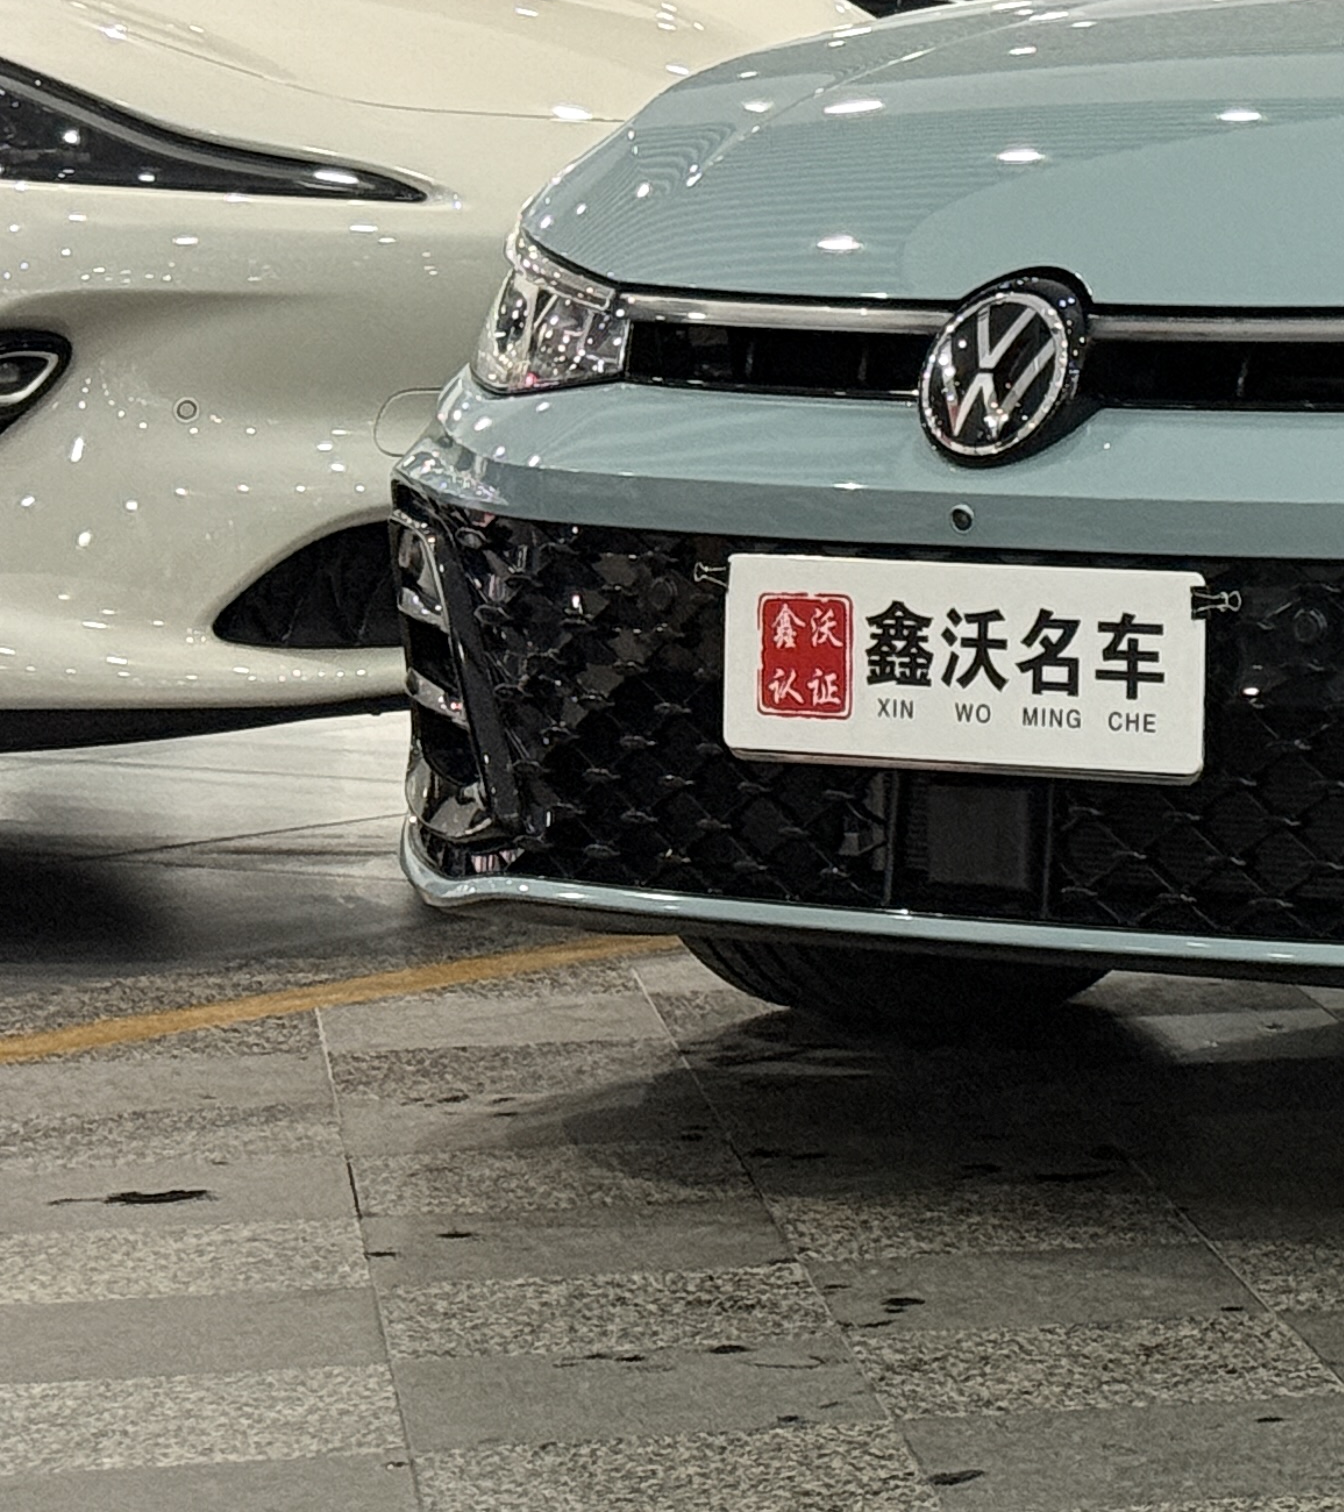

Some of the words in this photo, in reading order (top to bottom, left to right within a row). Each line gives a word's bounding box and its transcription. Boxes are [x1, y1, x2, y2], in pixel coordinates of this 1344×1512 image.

[771, 602, 844, 649] 鑫沃
[864, 600, 1166, 701] 鑫沃名车
[768, 667, 843, 706] 认证
[876, 697, 915, 720] XIN
[954, 701, 993, 725] WO
[1021, 706, 1082, 730] MING
[1107, 710, 1157, 734] CHE
